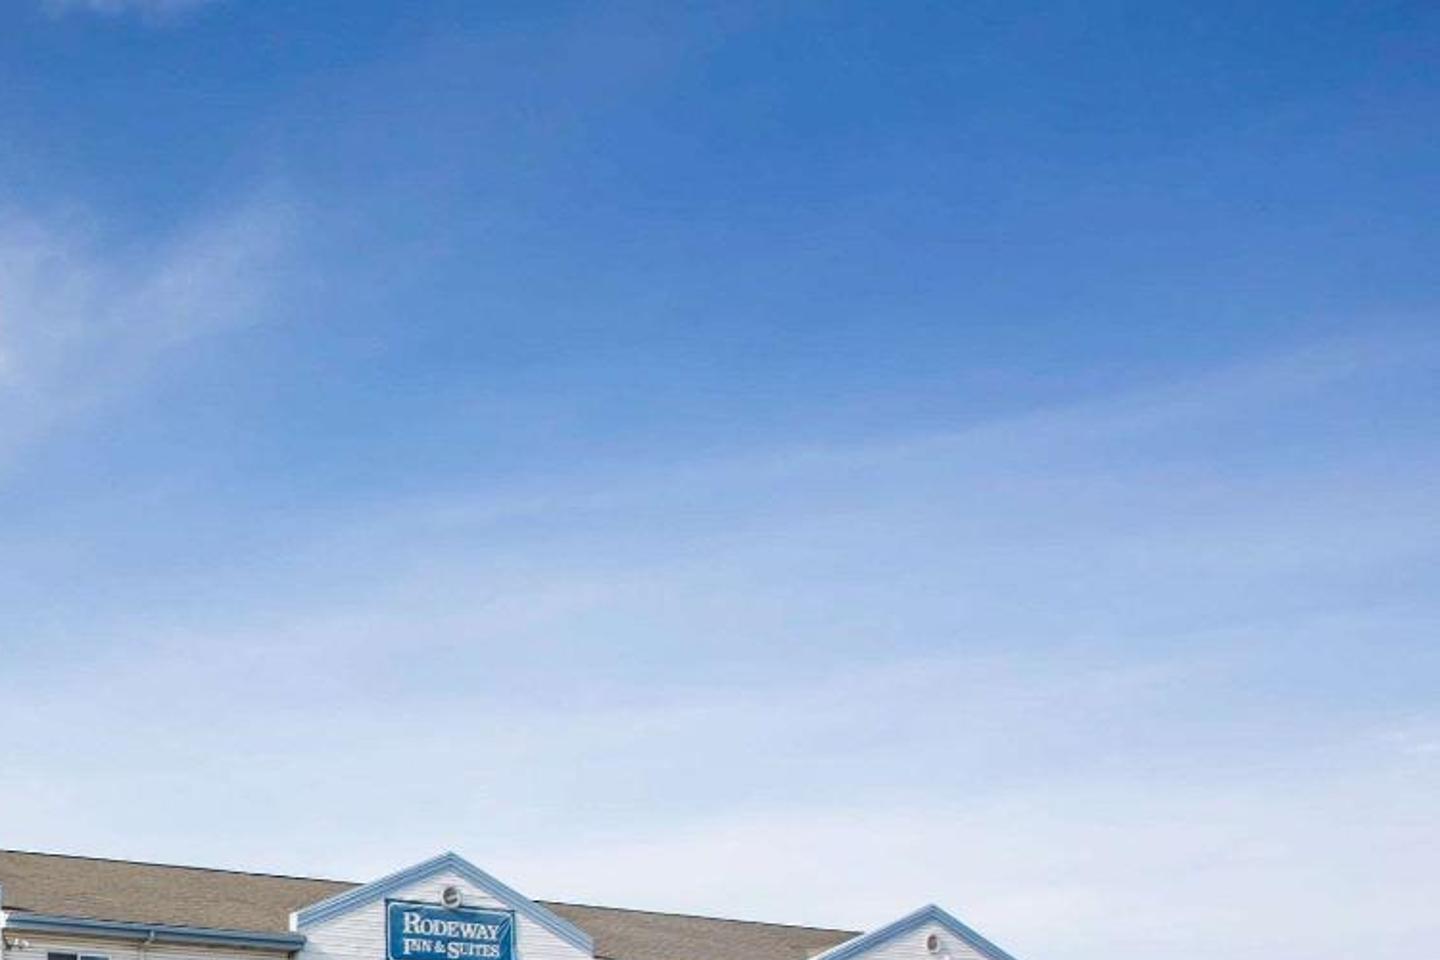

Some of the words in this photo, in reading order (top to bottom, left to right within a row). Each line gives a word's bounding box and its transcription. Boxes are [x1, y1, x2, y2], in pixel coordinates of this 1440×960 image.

[403, 912, 500, 940] RODEWAY
[403, 938, 433, 955] INN
[434, 940, 446, 953] &
[447, 941, 500, 959] SUITES
